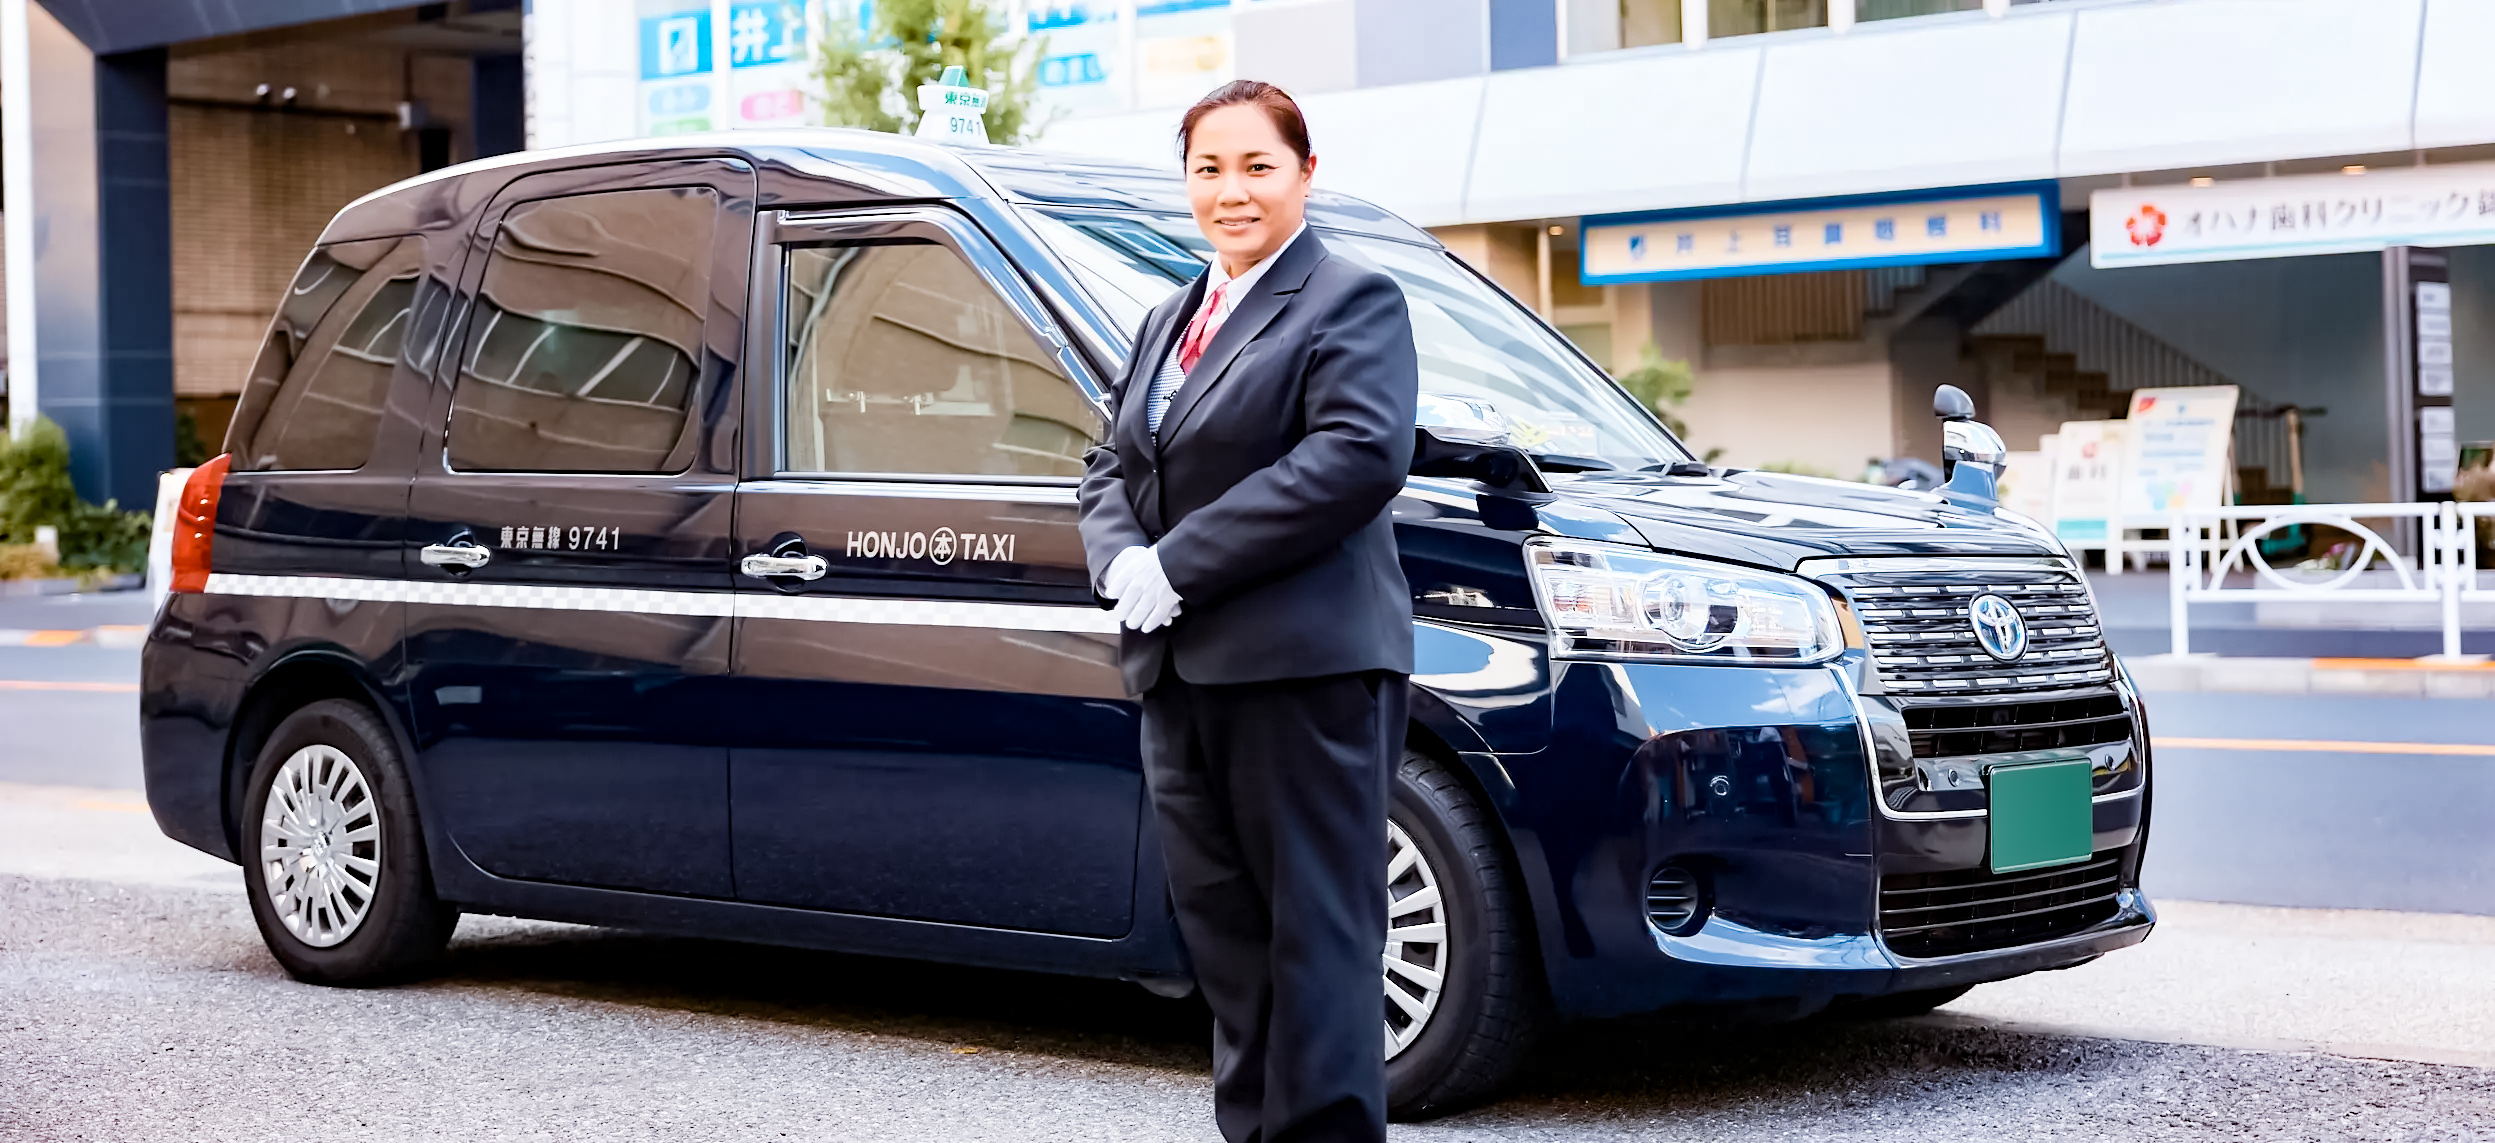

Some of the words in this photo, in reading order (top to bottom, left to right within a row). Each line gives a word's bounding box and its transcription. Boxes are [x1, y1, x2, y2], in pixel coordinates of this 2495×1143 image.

[951, 117, 980, 135] 9741
[500, 526, 561, 549] 東京無線
[568, 526, 620, 550] 9741
[846, 531, 927, 560] HONJO
[960, 533, 1016, 562] TAXI
